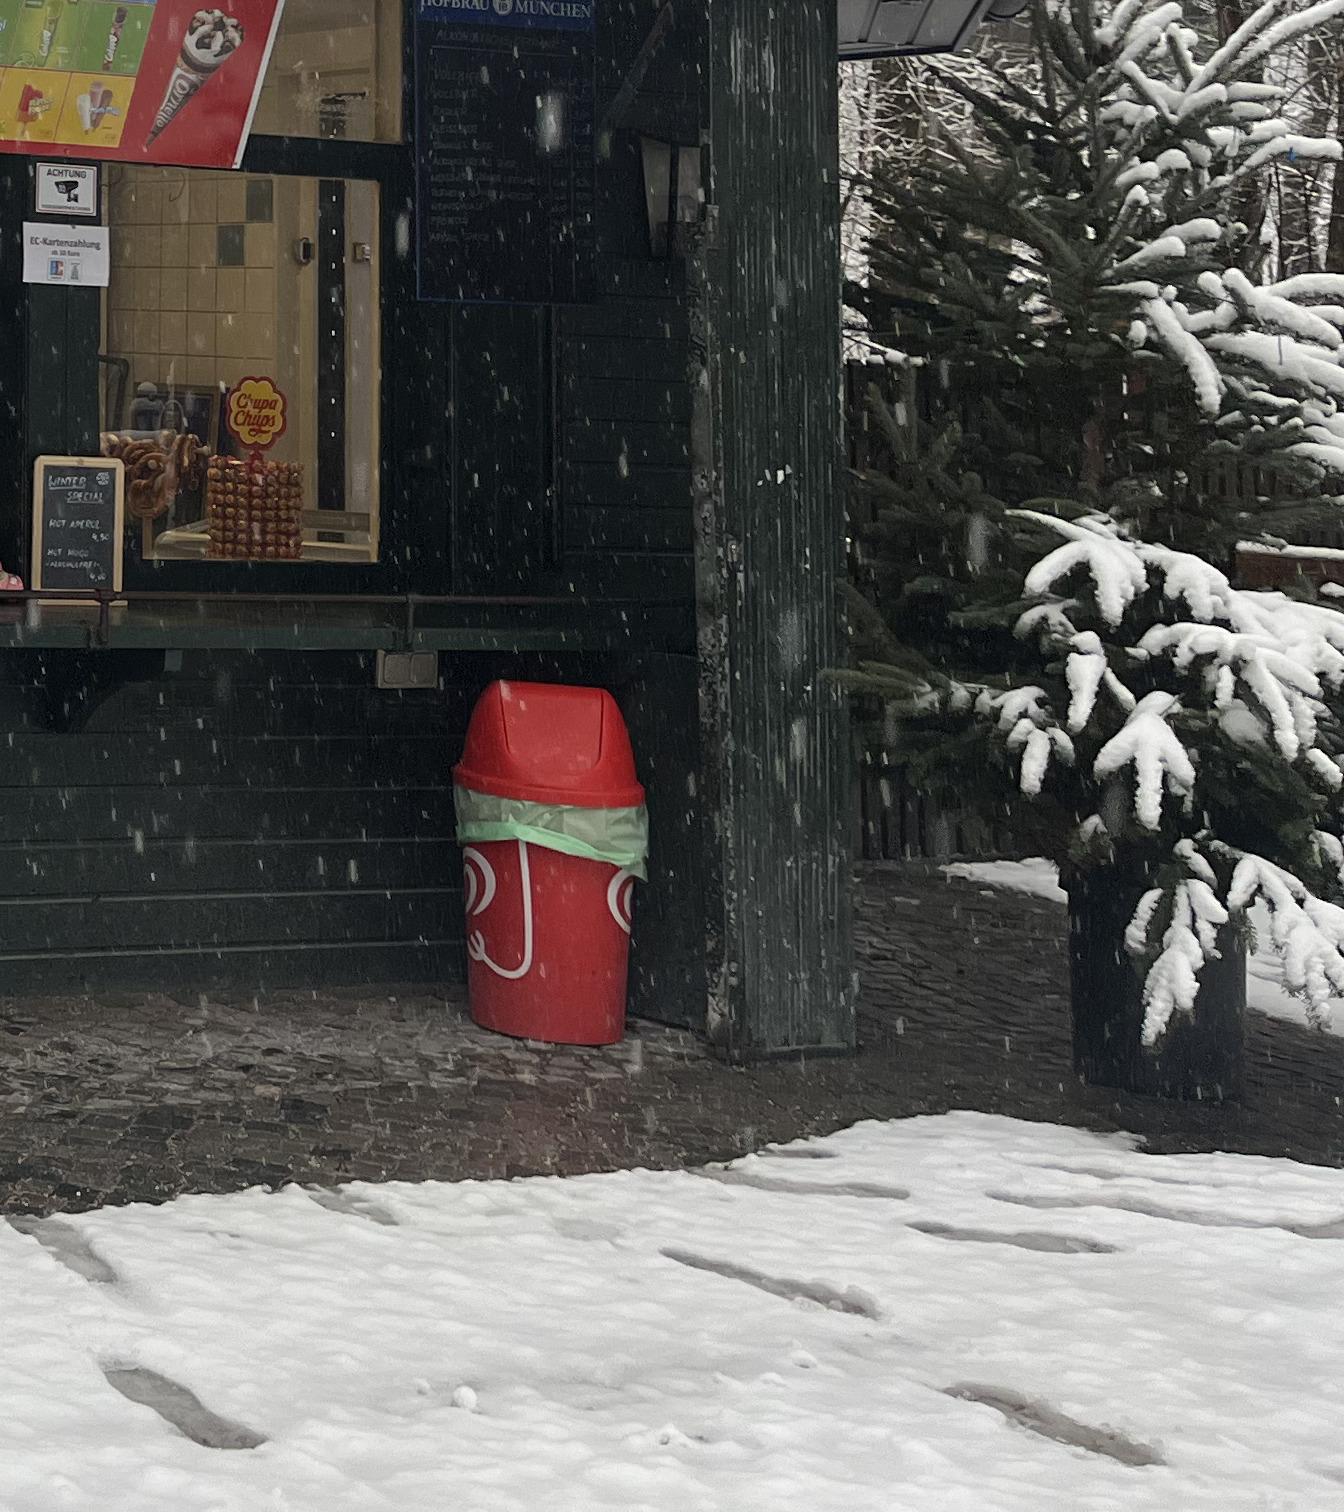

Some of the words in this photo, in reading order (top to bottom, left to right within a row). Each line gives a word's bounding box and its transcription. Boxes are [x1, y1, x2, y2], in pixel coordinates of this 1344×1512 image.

[46, 168, 87, 179] ACHTUNG
[30, 236, 101, 251] EC-Kartenzahlung
[233, 410, 277, 434] Chups
[48, 475, 87, 488] WINTER
[66, 491, 104, 503] SPECIAL
